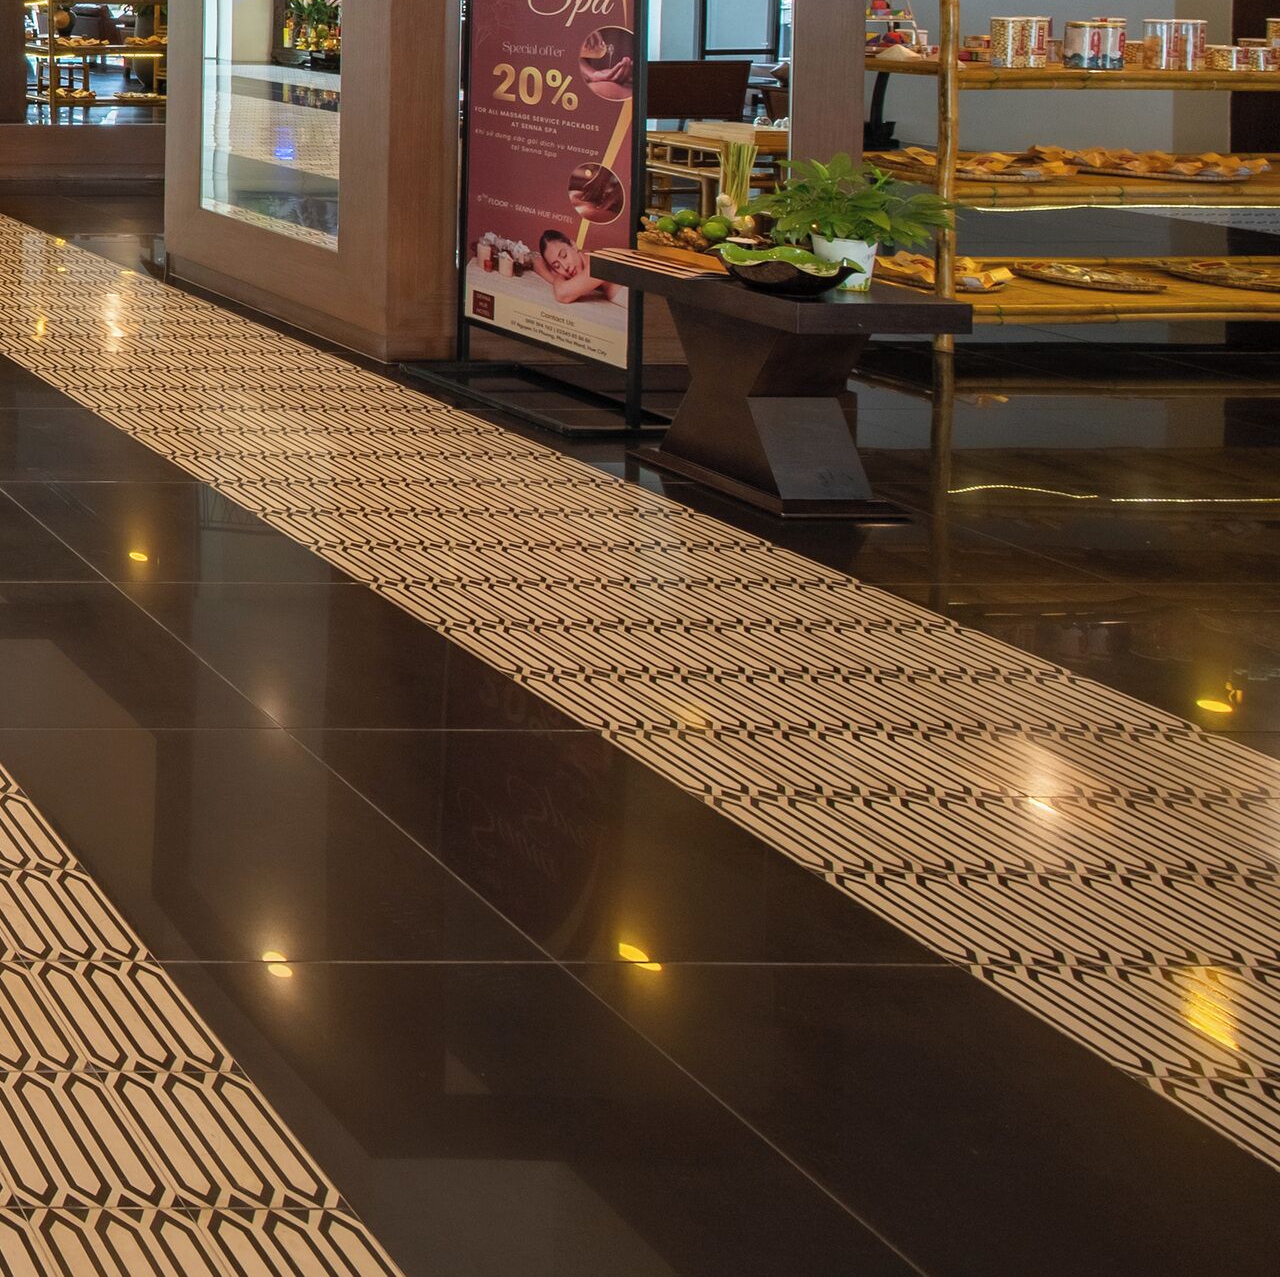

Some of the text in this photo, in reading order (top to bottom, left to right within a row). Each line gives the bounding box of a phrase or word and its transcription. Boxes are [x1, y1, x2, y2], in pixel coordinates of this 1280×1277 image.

[502, 42, 565, 57] Special offer
[492, 63, 579, 111] 20%
[500, 110, 530, 121] MASSAGE
[532, 115, 560, 126] SERVICE
[561, 120, 600, 132] PACKAGES
[521, 122, 543, 132] SENNA
[544, 126, 558, 134] SPA
[521, 145, 543, 155] Senna
[544, 150, 558, 159] Spa
[566, 144, 600, 156] Massage
[488, 197, 509, 208] FLOOR
[515, 204, 536, 215] SENNA
[538, 210, 551, 218] HUE
[552, 213, 574, 224] HOTEL
[540, 311, 565, 324] Contact
